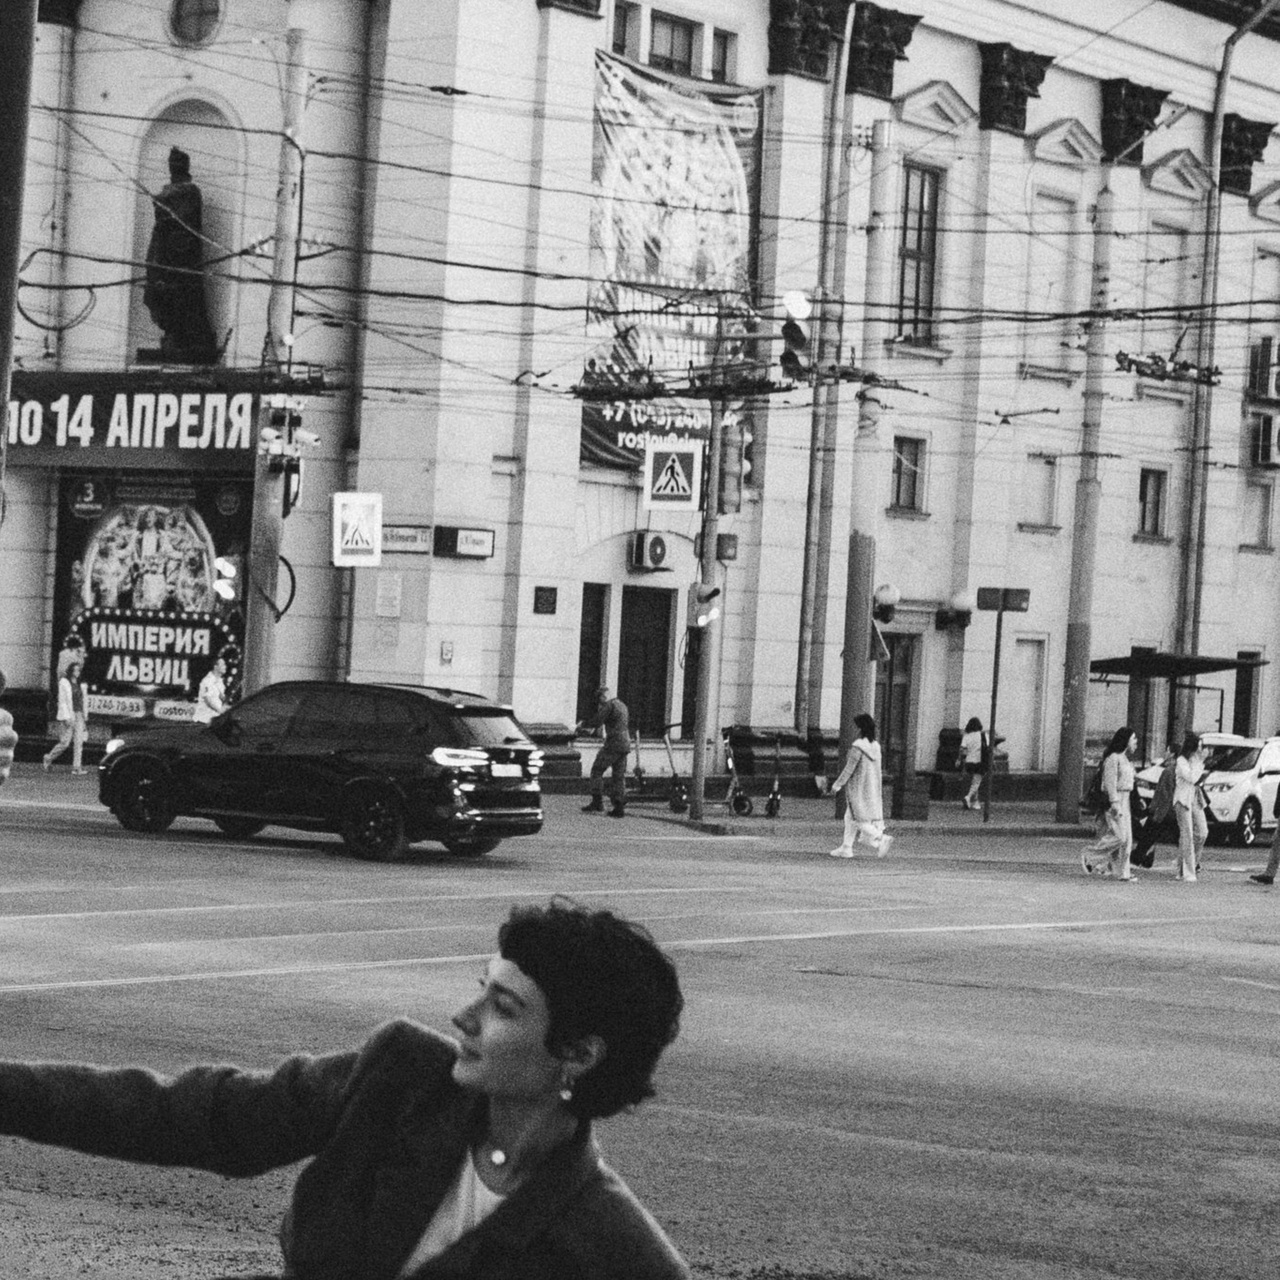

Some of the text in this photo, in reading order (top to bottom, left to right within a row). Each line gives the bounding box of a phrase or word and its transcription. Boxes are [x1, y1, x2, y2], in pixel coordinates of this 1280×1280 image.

[50, 393, 94, 447] 14
[106, 393, 253, 449] АПРЕЛЯ
[602, 402, 626, 422] +7
[91, 622, 210, 655] ИМПЕРИЯ
[107, 655, 190, 691] ЛЬВИЦ
